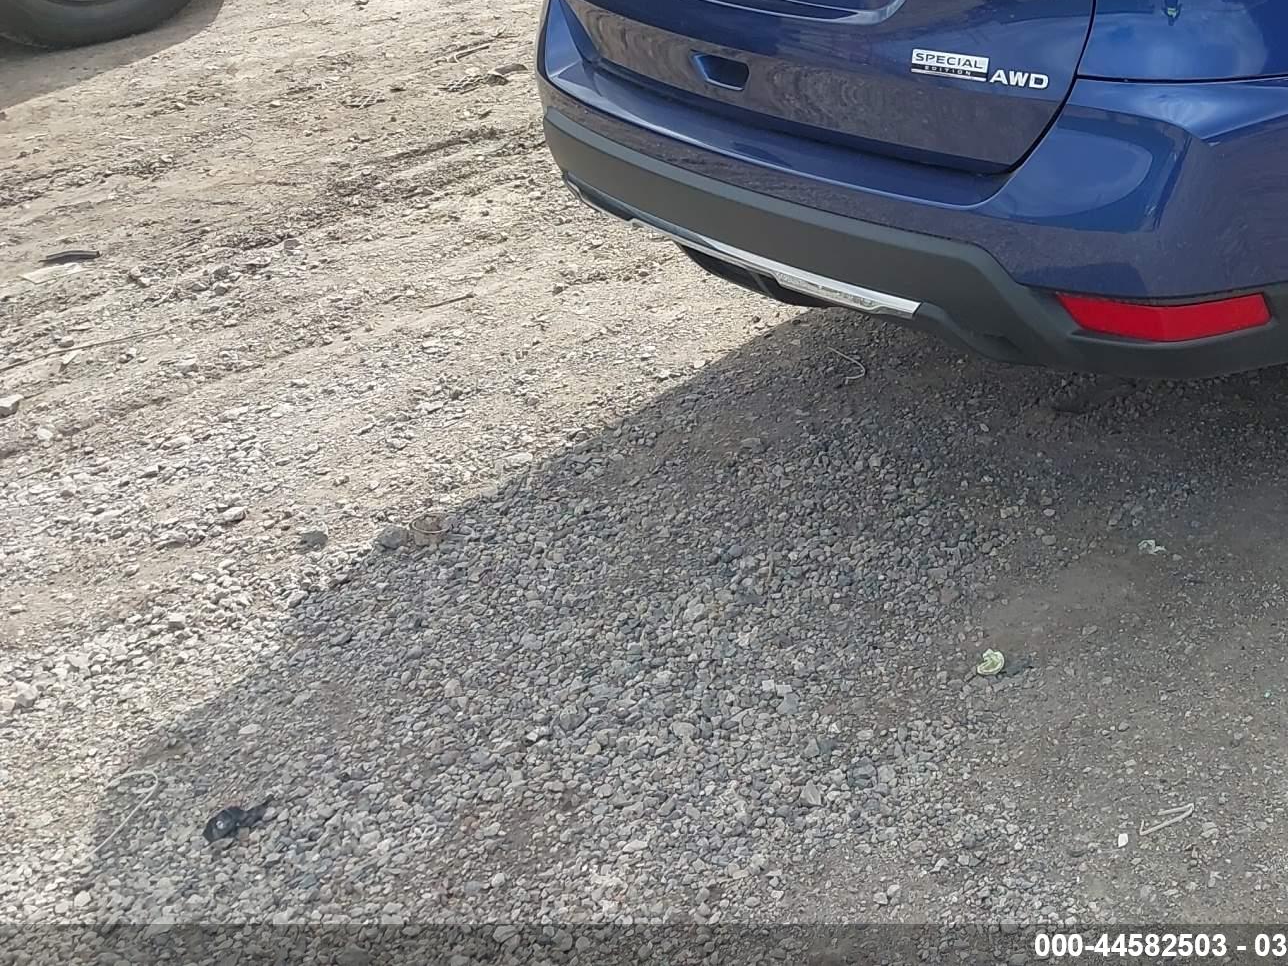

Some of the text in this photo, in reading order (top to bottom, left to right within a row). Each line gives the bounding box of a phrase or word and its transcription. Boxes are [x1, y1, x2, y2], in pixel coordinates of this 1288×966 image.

[915, 52, 984, 70] SPECIAL
[924, 65, 972, 76] EDITION
[989, 69, 1049, 89] AWD
